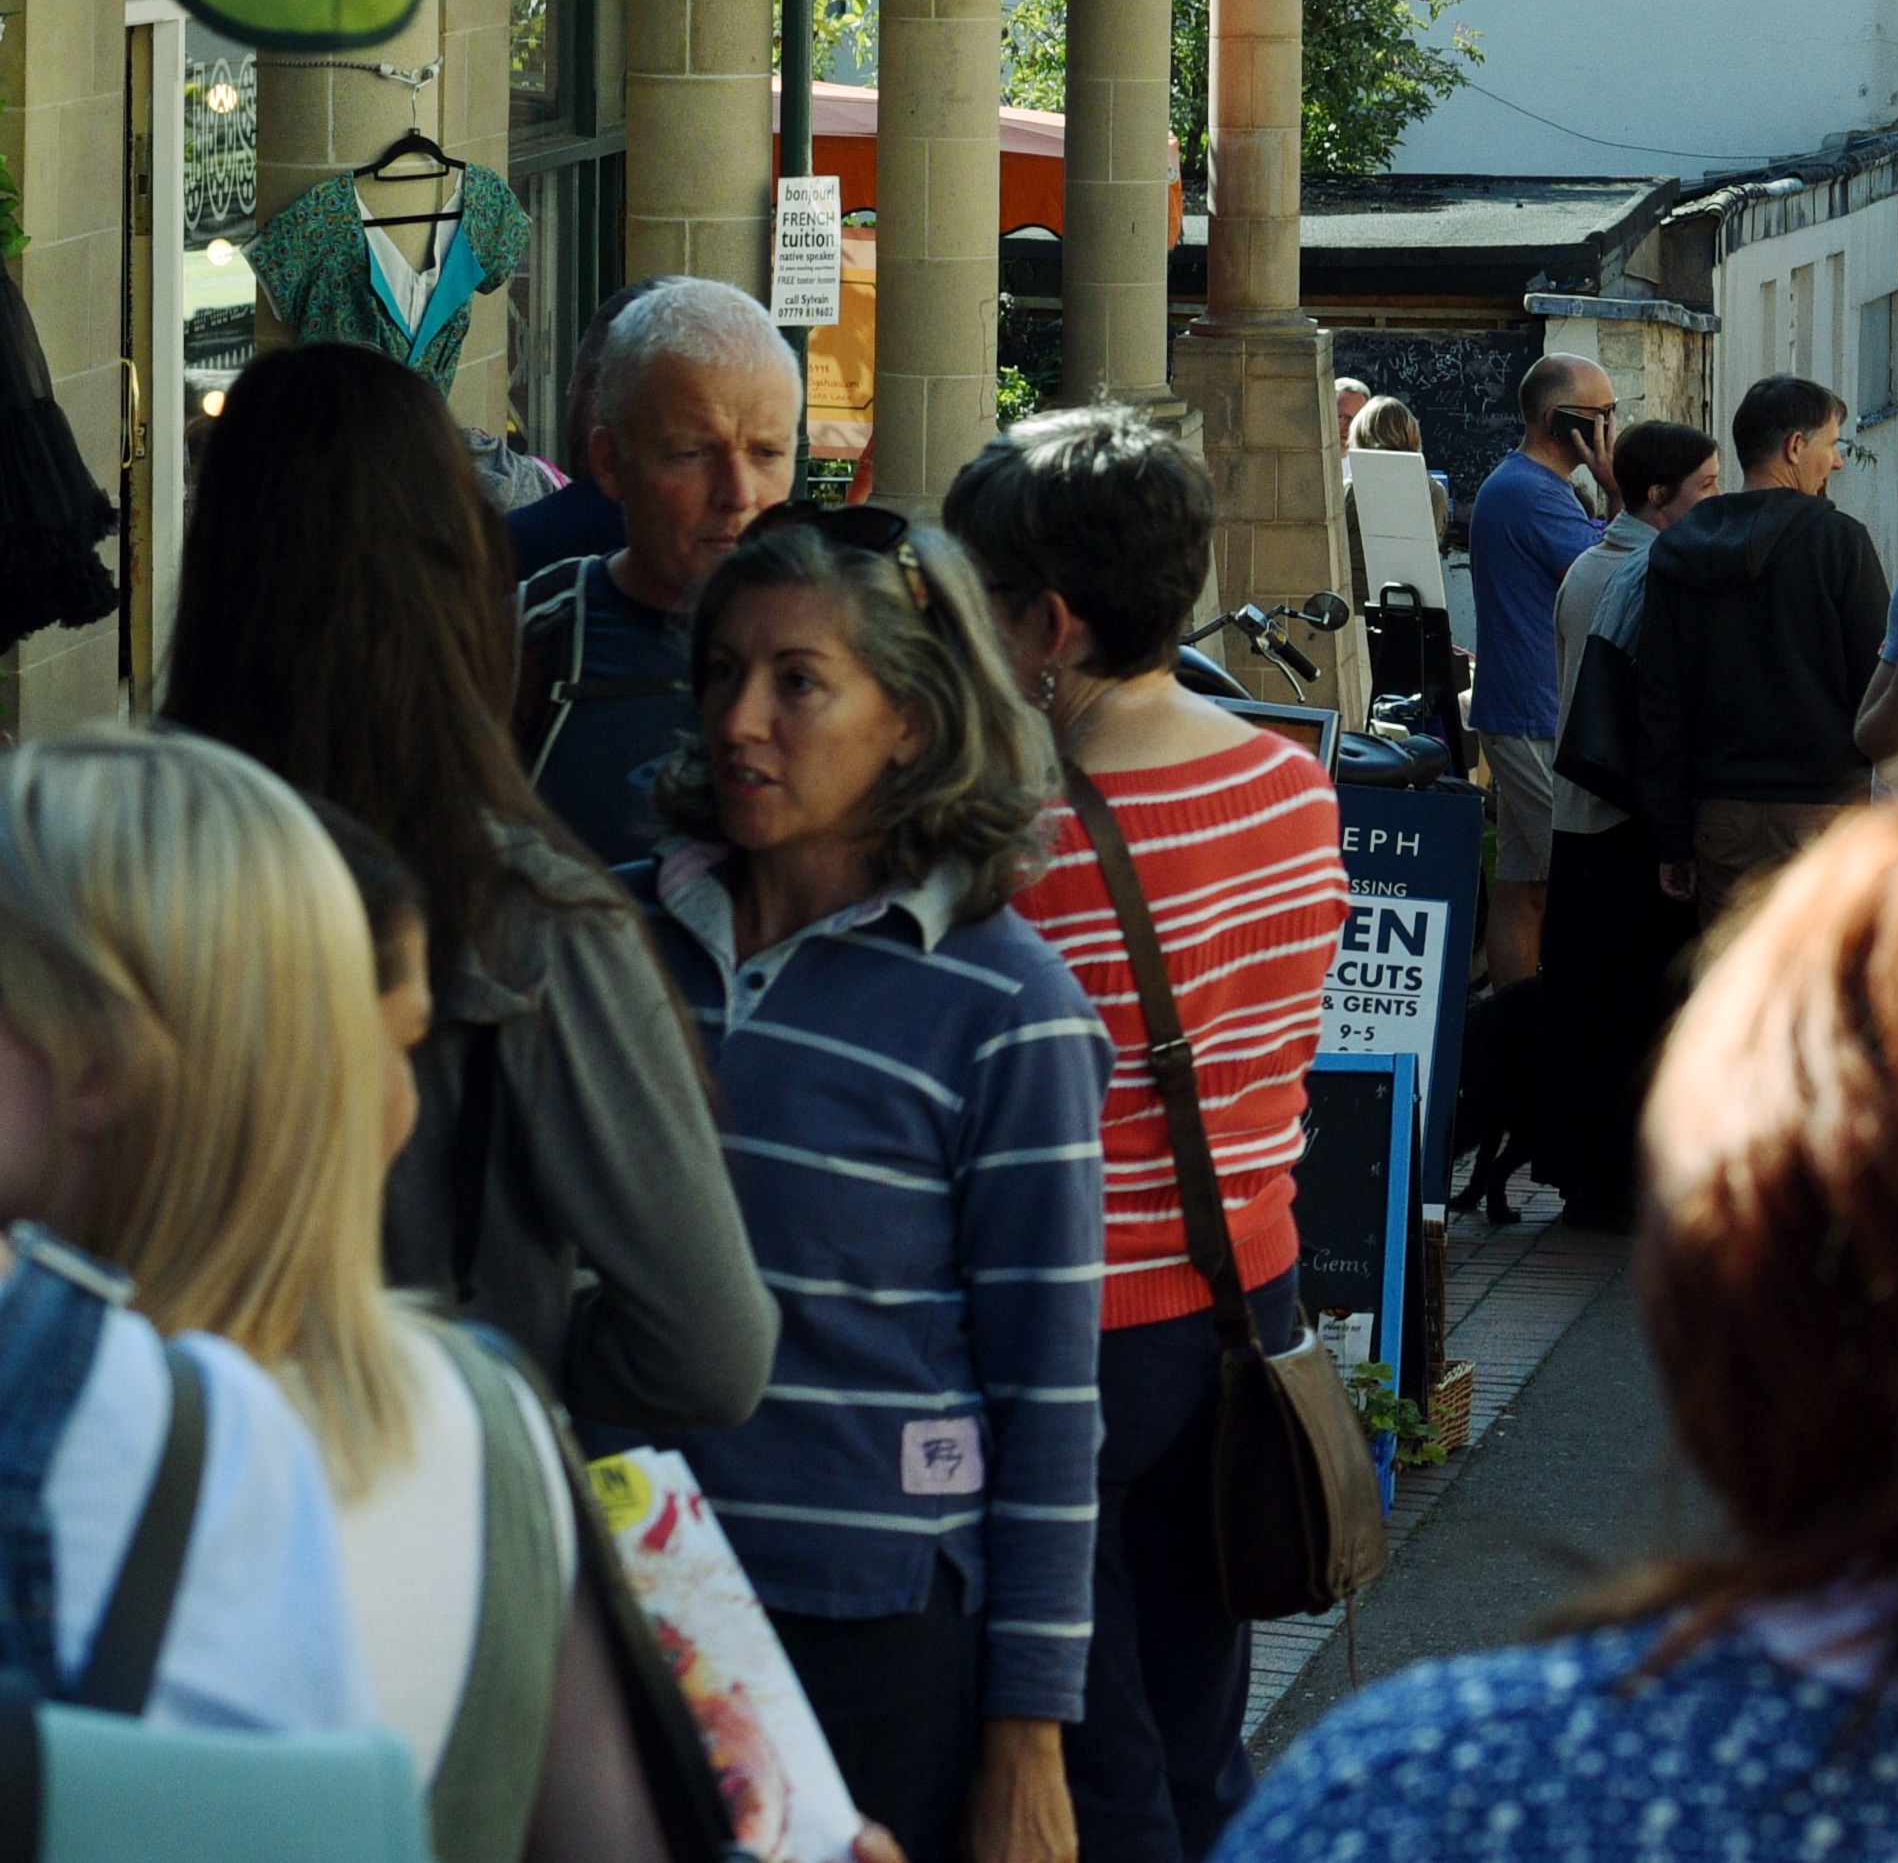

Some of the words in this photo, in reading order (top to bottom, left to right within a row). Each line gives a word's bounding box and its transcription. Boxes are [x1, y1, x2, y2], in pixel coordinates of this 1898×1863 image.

[785, 184, 835, 206] bonjour!
[782, 211, 836, 227] FRENCH
[782, 228, 835, 248] tuition
[779, 251, 804, 262] native
[806, 251, 836, 264] speaker
[777, 275, 796, 285] FREE
[784, 294, 799, 306] call
[801, 294, 829, 308] Sylvain
[778, 306, 803, 318] 07779
[1342, 826, 1420, 857] EPH
[1350, 878, 1408, 898] SSING
[1341, 904, 1429, 957] EN
[1321, 994, 1335, 1011] &
[1343, 995, 1418, 1017] GENTS
[1339, 1023, 1376, 1042] 9-5
